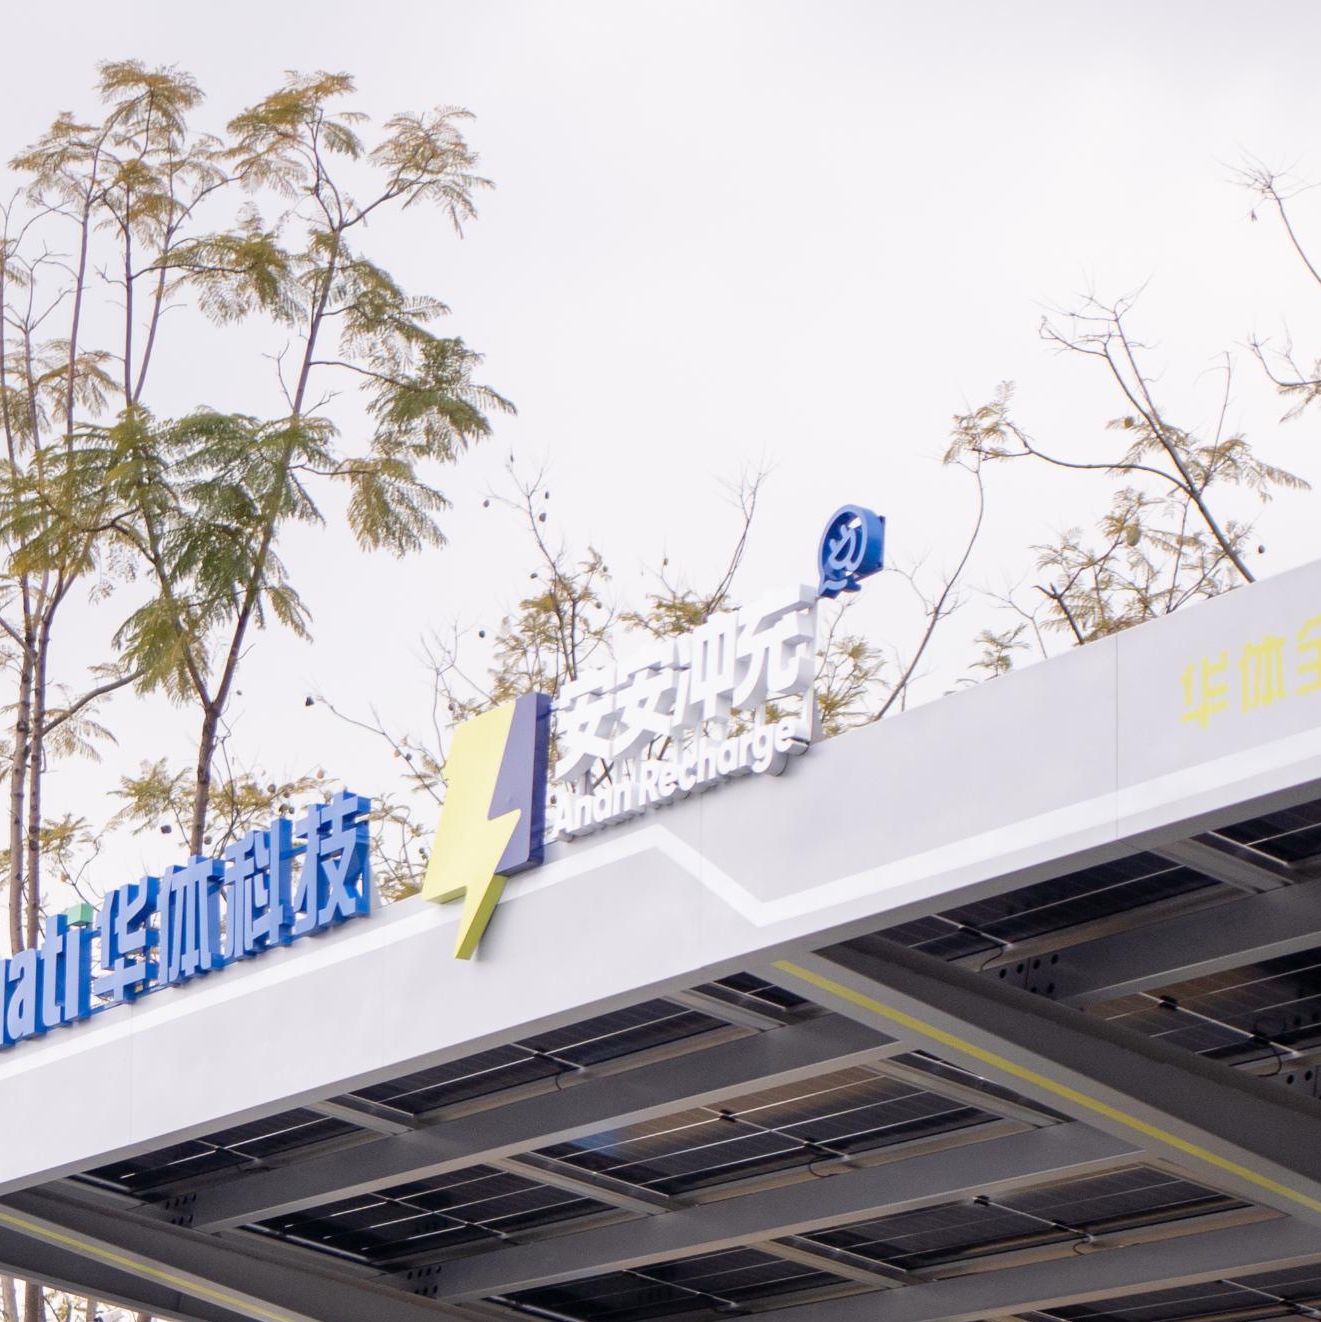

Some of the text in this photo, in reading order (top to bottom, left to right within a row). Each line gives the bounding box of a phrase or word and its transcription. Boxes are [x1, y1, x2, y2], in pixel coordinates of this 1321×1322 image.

[551, 717, 797, 834] Anan Recharge
[94, 791, 371, 1004] 华体科技
